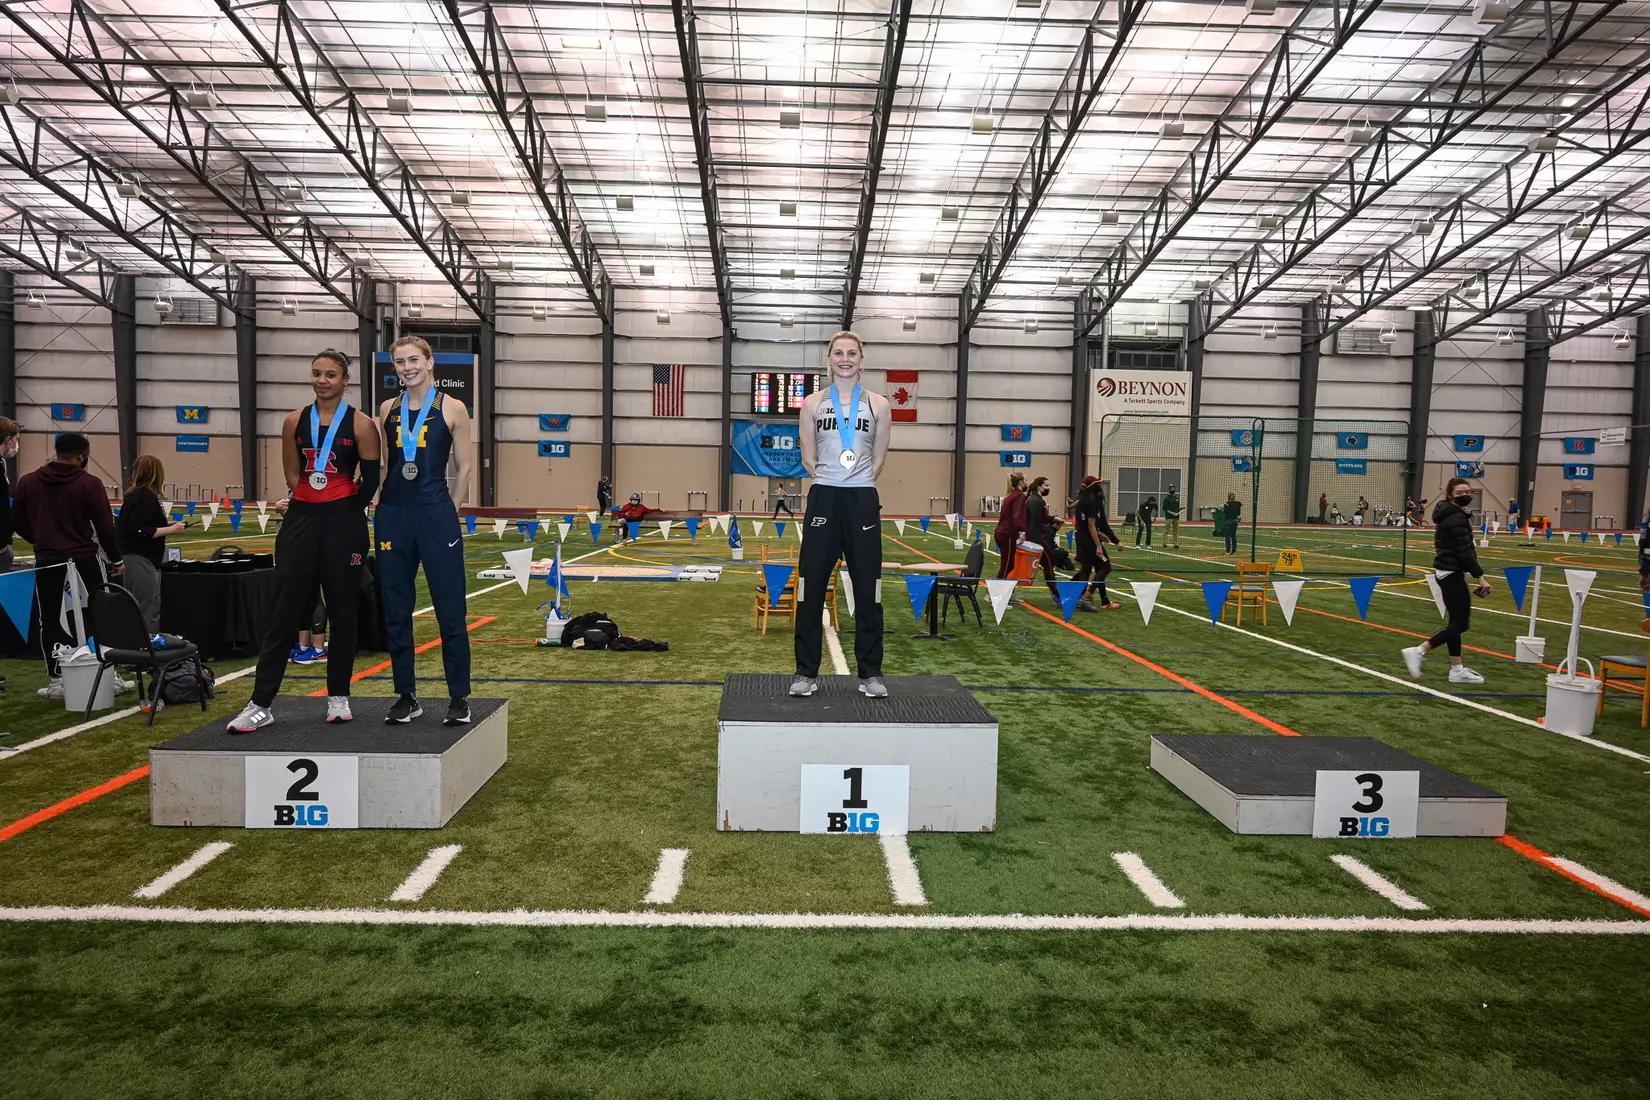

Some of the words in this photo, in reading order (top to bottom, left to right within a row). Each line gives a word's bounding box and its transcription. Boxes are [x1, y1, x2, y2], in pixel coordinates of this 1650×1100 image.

[441, 379, 465, 388] Clinic
[1117, 381, 1187, 396] BEYNON
[184, 409, 199, 420] M
[1011, 427, 1022, 438] N
[1462, 438, 1478, 447] P
[811, 517, 827, 527] P
[380, 541, 392, 551] M
[351, 553, 361, 565] R
[286, 758, 319, 801] 2
[843, 767, 868, 808] 1
[1352, 773, 1384, 813] 3
